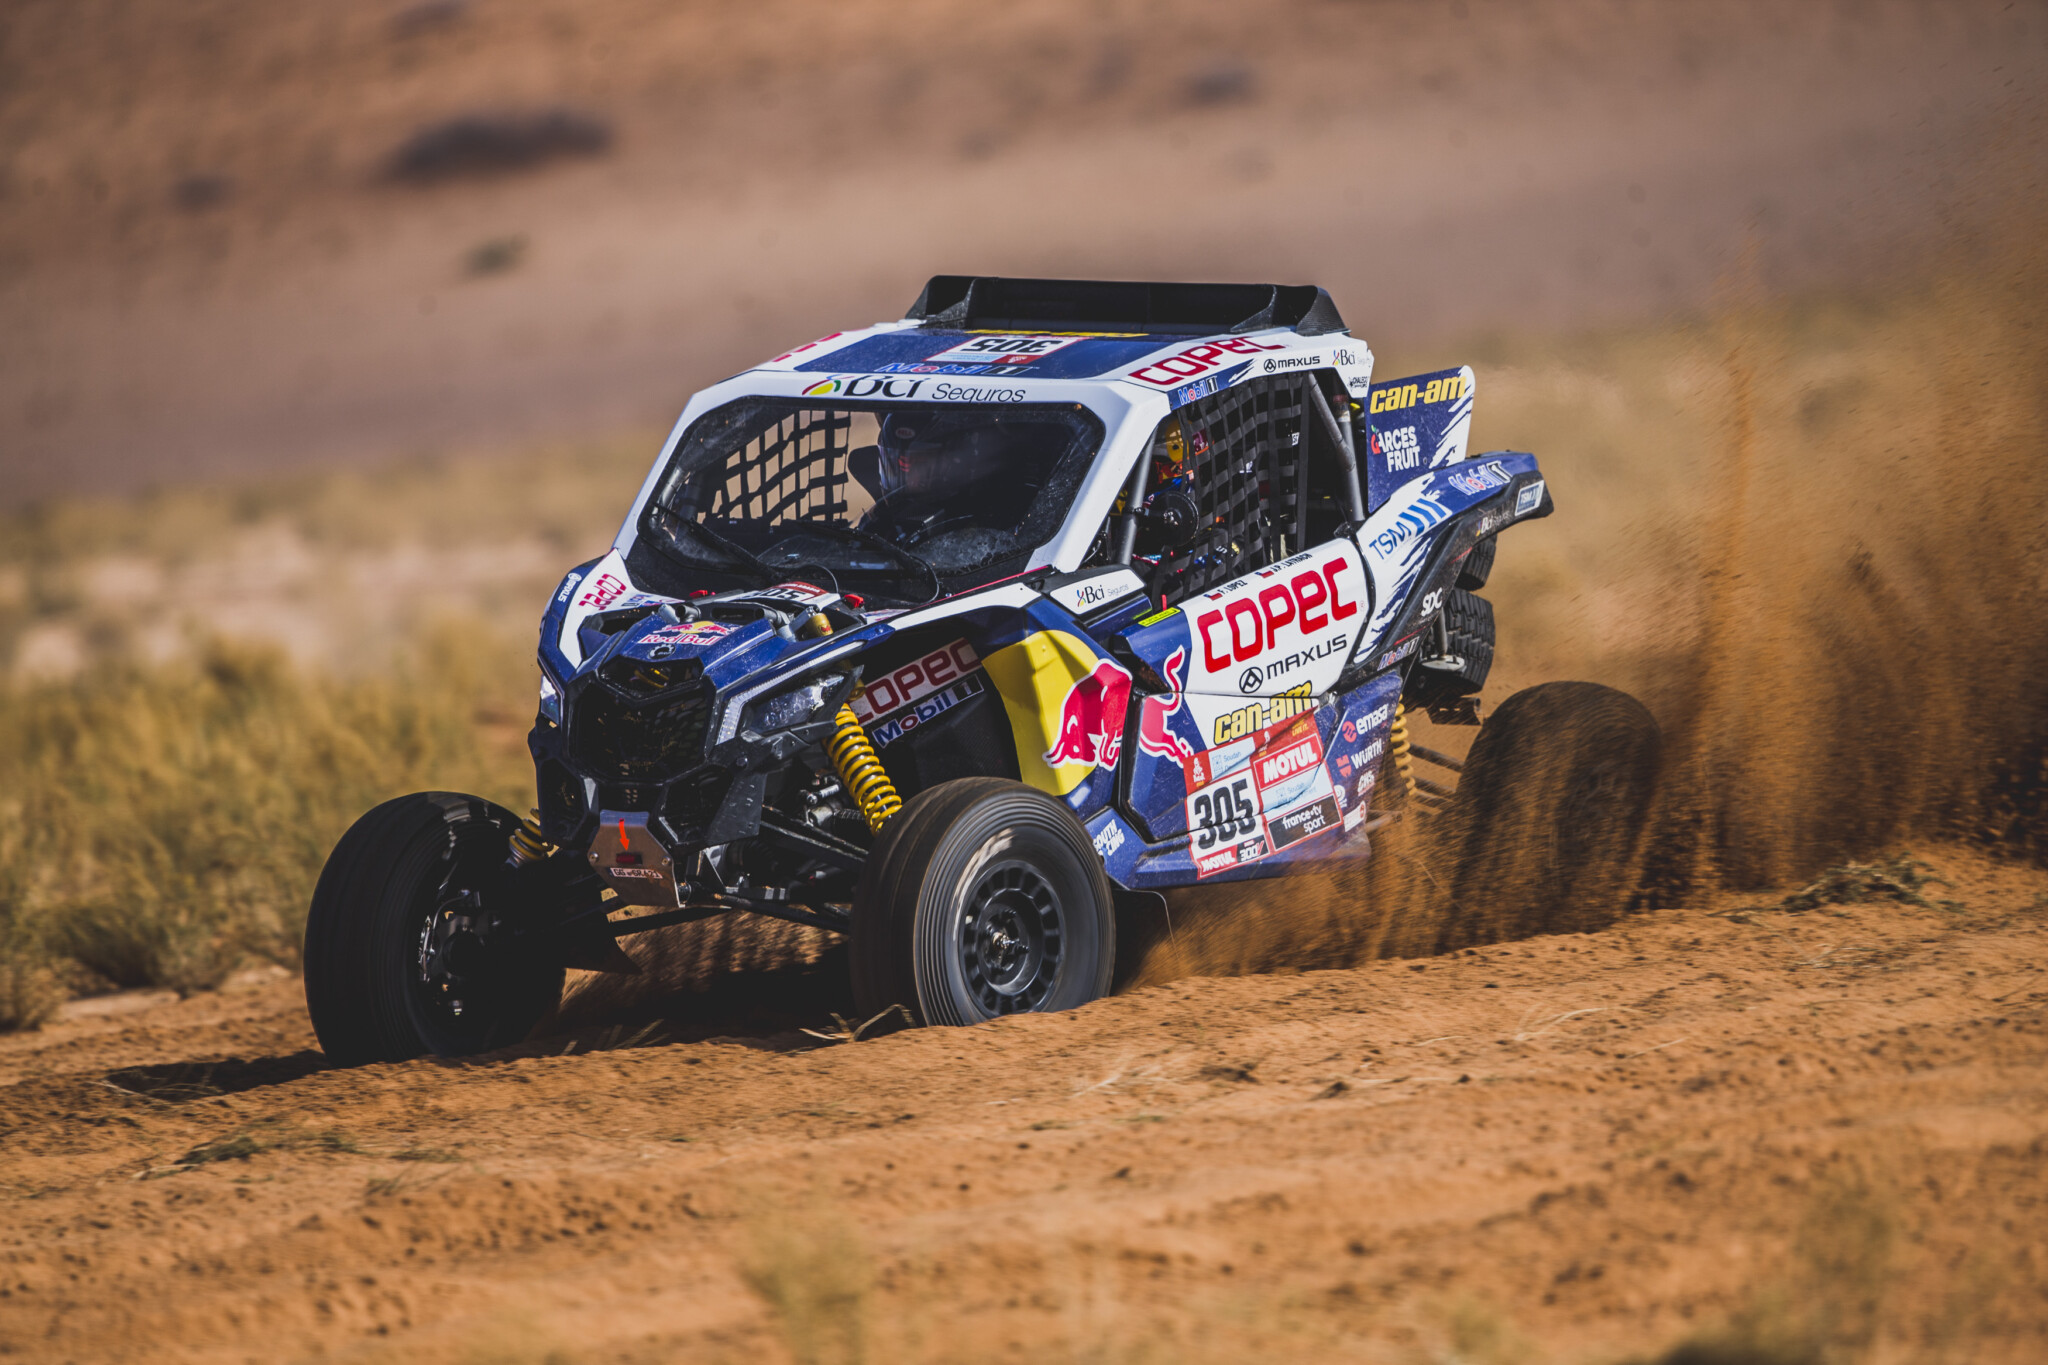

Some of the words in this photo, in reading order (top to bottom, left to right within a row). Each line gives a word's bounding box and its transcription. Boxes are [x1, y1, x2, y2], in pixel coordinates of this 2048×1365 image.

[874, 362, 993, 376] Mobil
[1127, 336, 1287, 386] COPEC
[1277, 355, 1321, 368] MAXUS
[1340, 349, 1356, 366] Bci
[931, 382, 1026, 403] Seguros
[1178, 380, 1208, 406] Mobil
[1369, 376, 1467, 414] can-am
[1387, 446, 1420, 472] FRUIT
[1448, 464, 1503, 496] Mobil
[1369, 521, 1412, 560] TSM
[578, 573, 627, 611] COPEC
[1084, 583, 1106, 605] Bci
[1224, 579, 1248, 592] LOPEZ
[1197, 557, 1358, 675] COPEC
[640, 634, 684, 644] Red
[678, 634, 722, 646] Bull
[1266, 634, 1348, 681] MAXUS
[871, 690, 952, 748] Mobil
[1212, 680, 1313, 746] can-am
[1355, 703, 1389, 735] emasa
[1262, 741, 1319, 785] MOTUL
[1194, 778, 1256, 850] 305
[1303, 814, 1326, 835] sport
[1200, 850, 1236, 873] MOTUL
[1239, 840, 1265, 862] 300V
